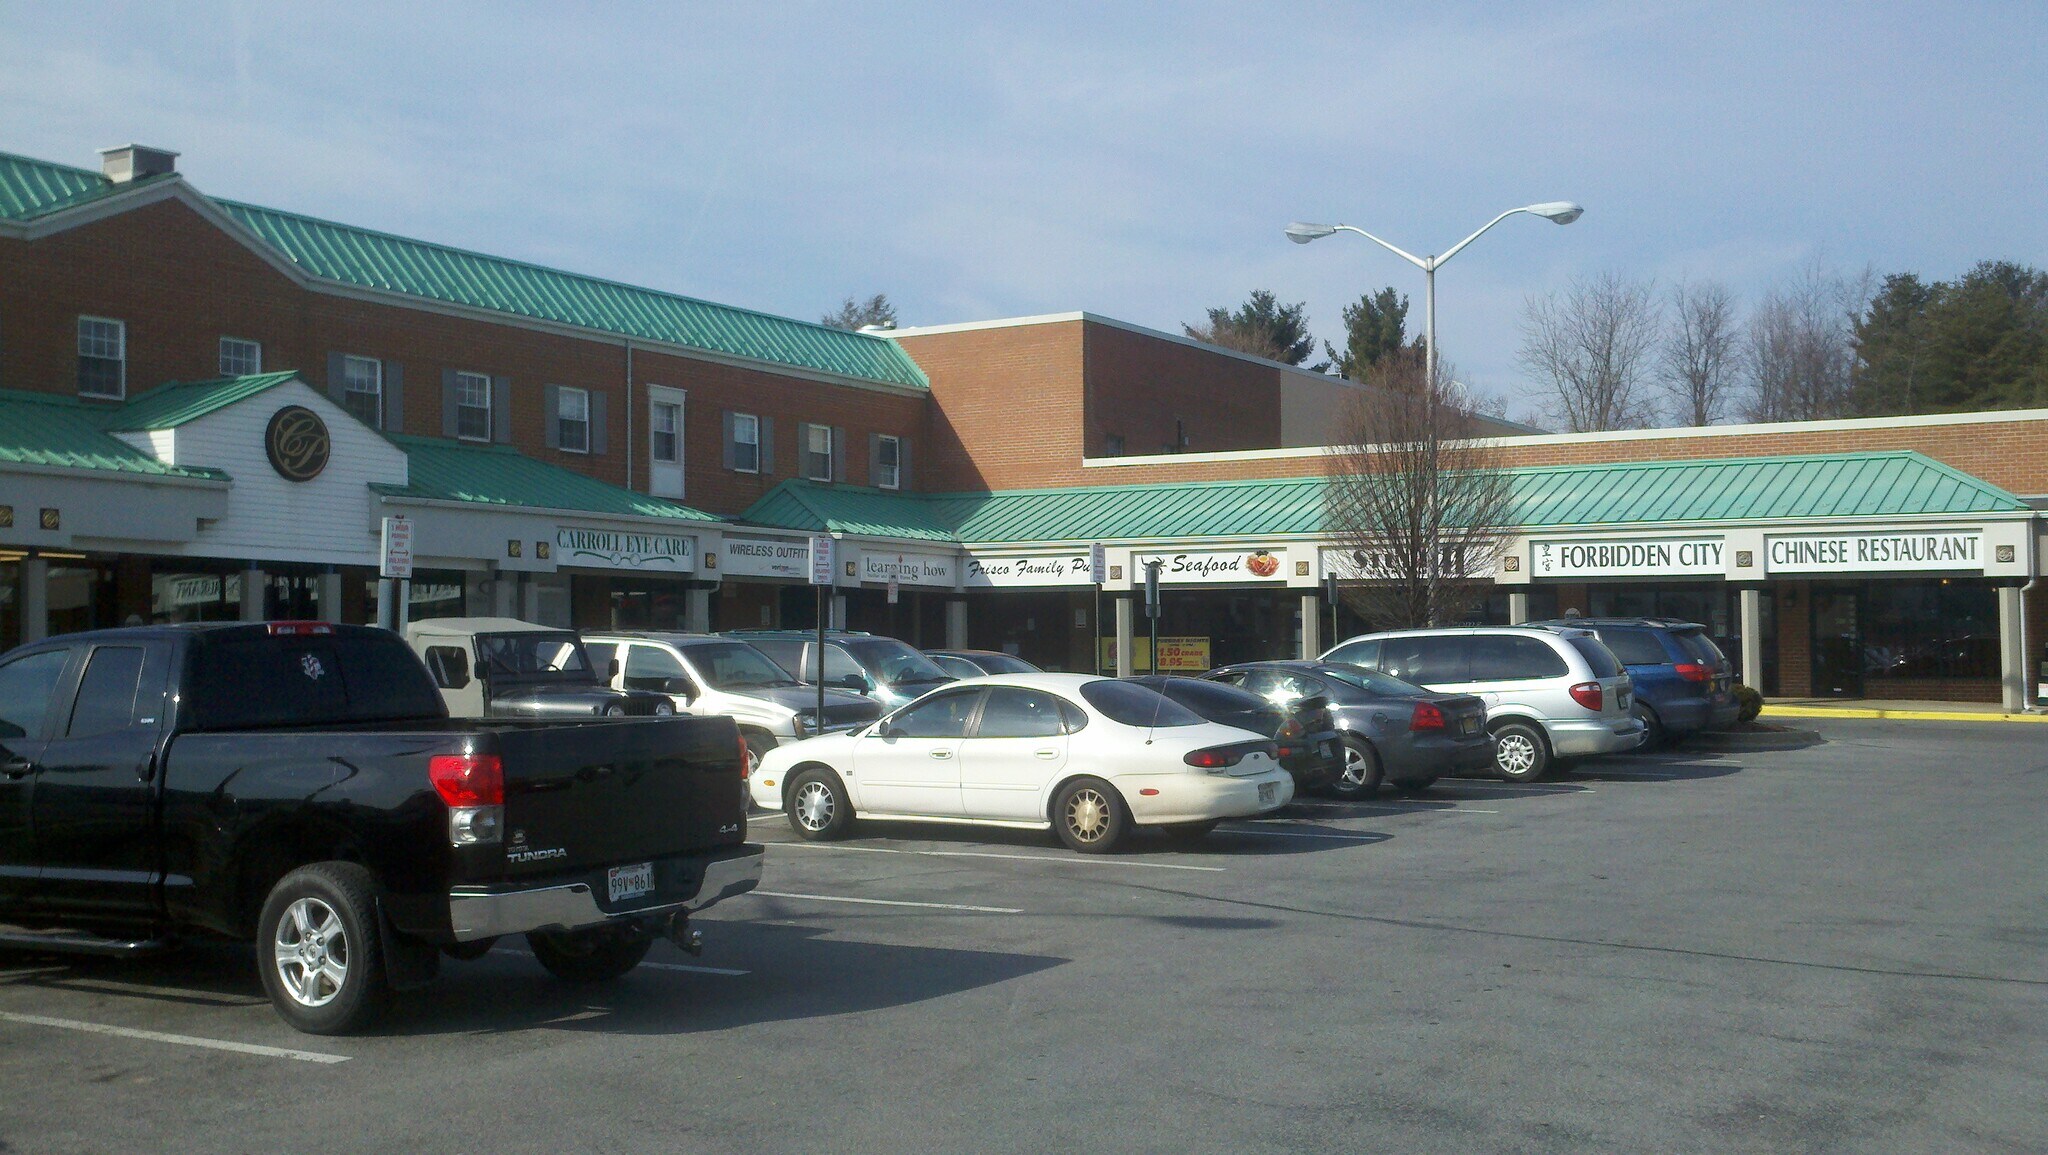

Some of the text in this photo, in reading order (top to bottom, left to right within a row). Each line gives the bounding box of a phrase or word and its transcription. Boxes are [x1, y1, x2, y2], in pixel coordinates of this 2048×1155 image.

[557, 529, 690, 556] CARROLL EYE CARE
[729, 544, 774, 557] WIRELESS
[1771, 536, 1979, 564] CHINESE RESTAURANT
[1171, 554, 1242, 577] Seafood
[1560, 543, 1724, 568] FORBIDDEN CITY
[923, 561, 947, 576] how
[968, 560, 1010, 578] Frisco
[1015, 559, 1064, 577] Family
[506, 847, 568, 863] TUNDRA
